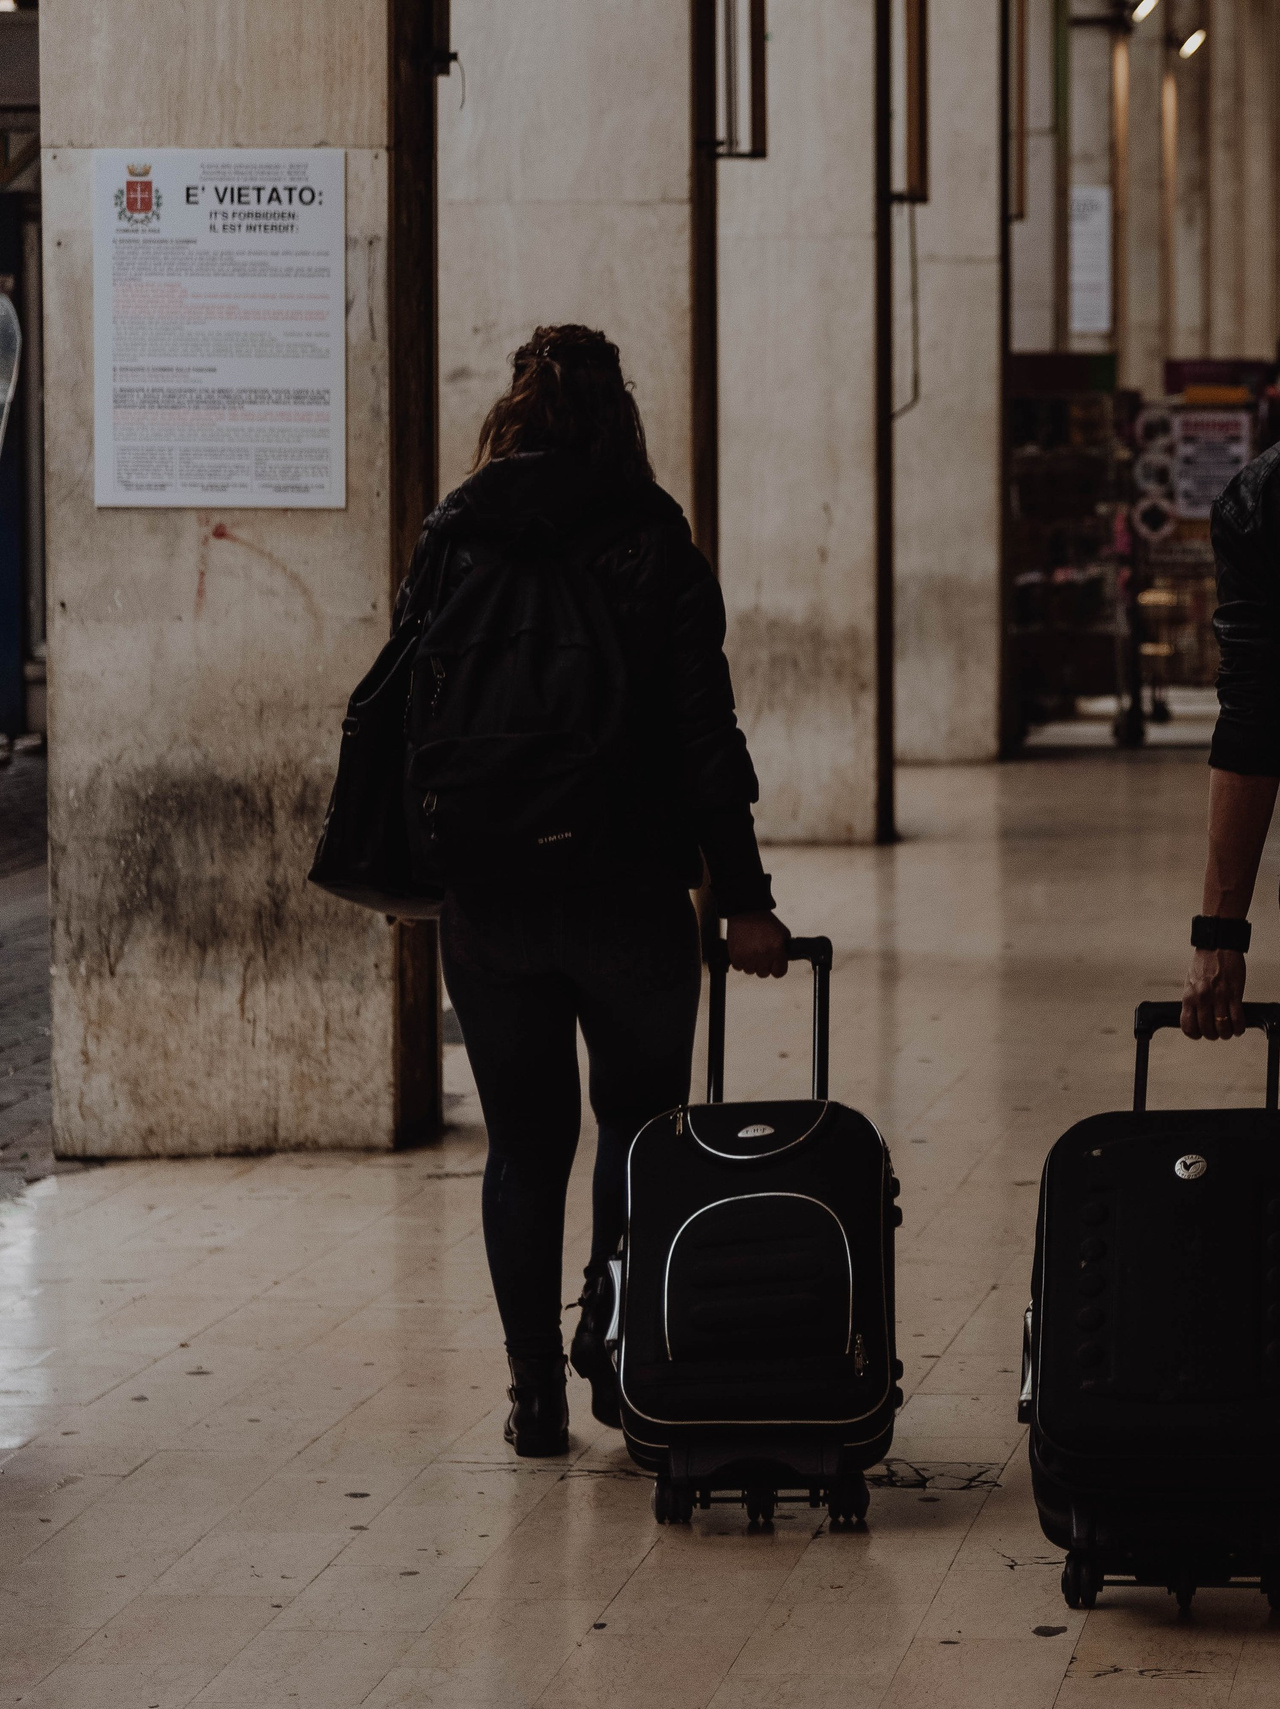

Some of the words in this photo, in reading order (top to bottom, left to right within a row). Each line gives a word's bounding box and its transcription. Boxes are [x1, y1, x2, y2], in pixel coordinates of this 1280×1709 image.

[185, 186, 206, 206] E'
[214, 186, 324, 206] VIETATO:
[209, 211, 229, 221] IT'S
[209, 224, 219, 233] IL
[222, 224, 242, 233] EST
